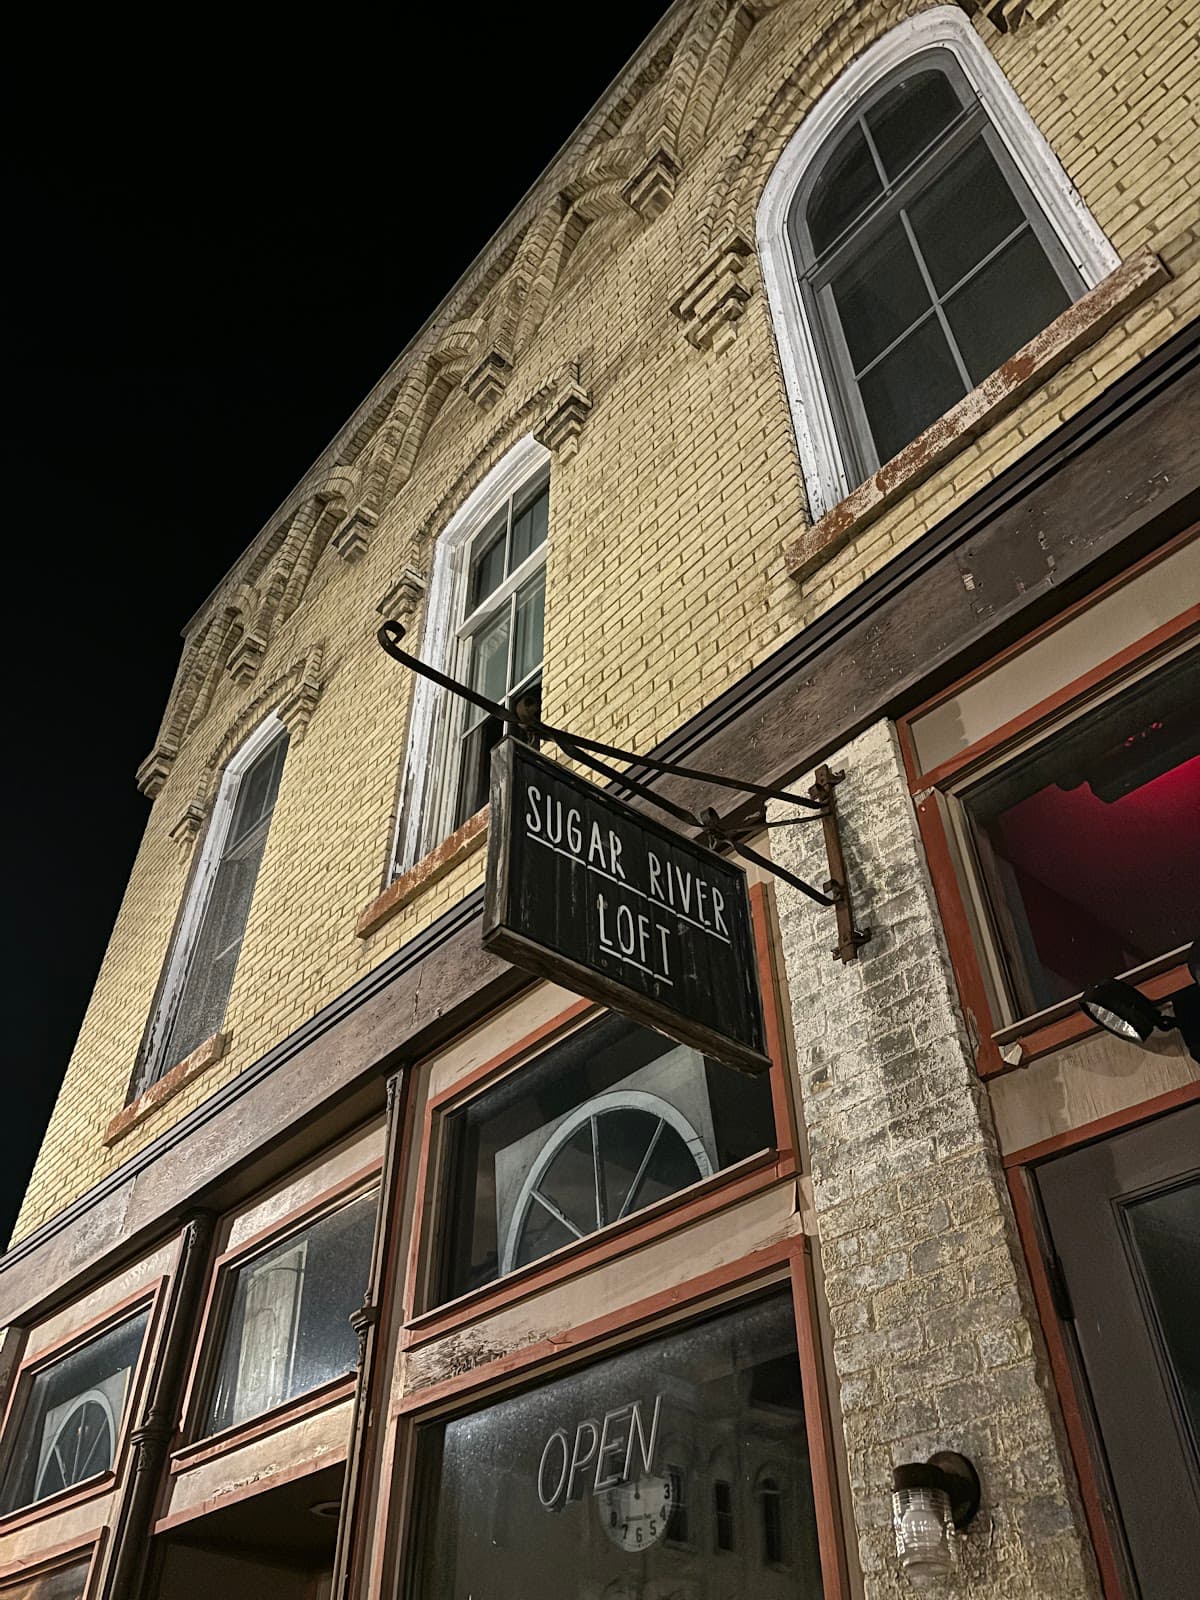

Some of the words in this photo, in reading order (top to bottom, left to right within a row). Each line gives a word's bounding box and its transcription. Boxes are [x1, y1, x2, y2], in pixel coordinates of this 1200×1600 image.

[526, 786, 626, 879] SUGAR
[648, 852, 729, 936] RIVER
[598, 893, 671, 975] LOFT
[537, 1393, 662, 1506] OPEN
[663, 1483, 671, 1499] 3
[659, 1505, 667, 1521] 4
[621, 1523, 629, 1539] 7
[635, 1527, 643, 1543] 6
[649, 1519, 657, 1536] 5
